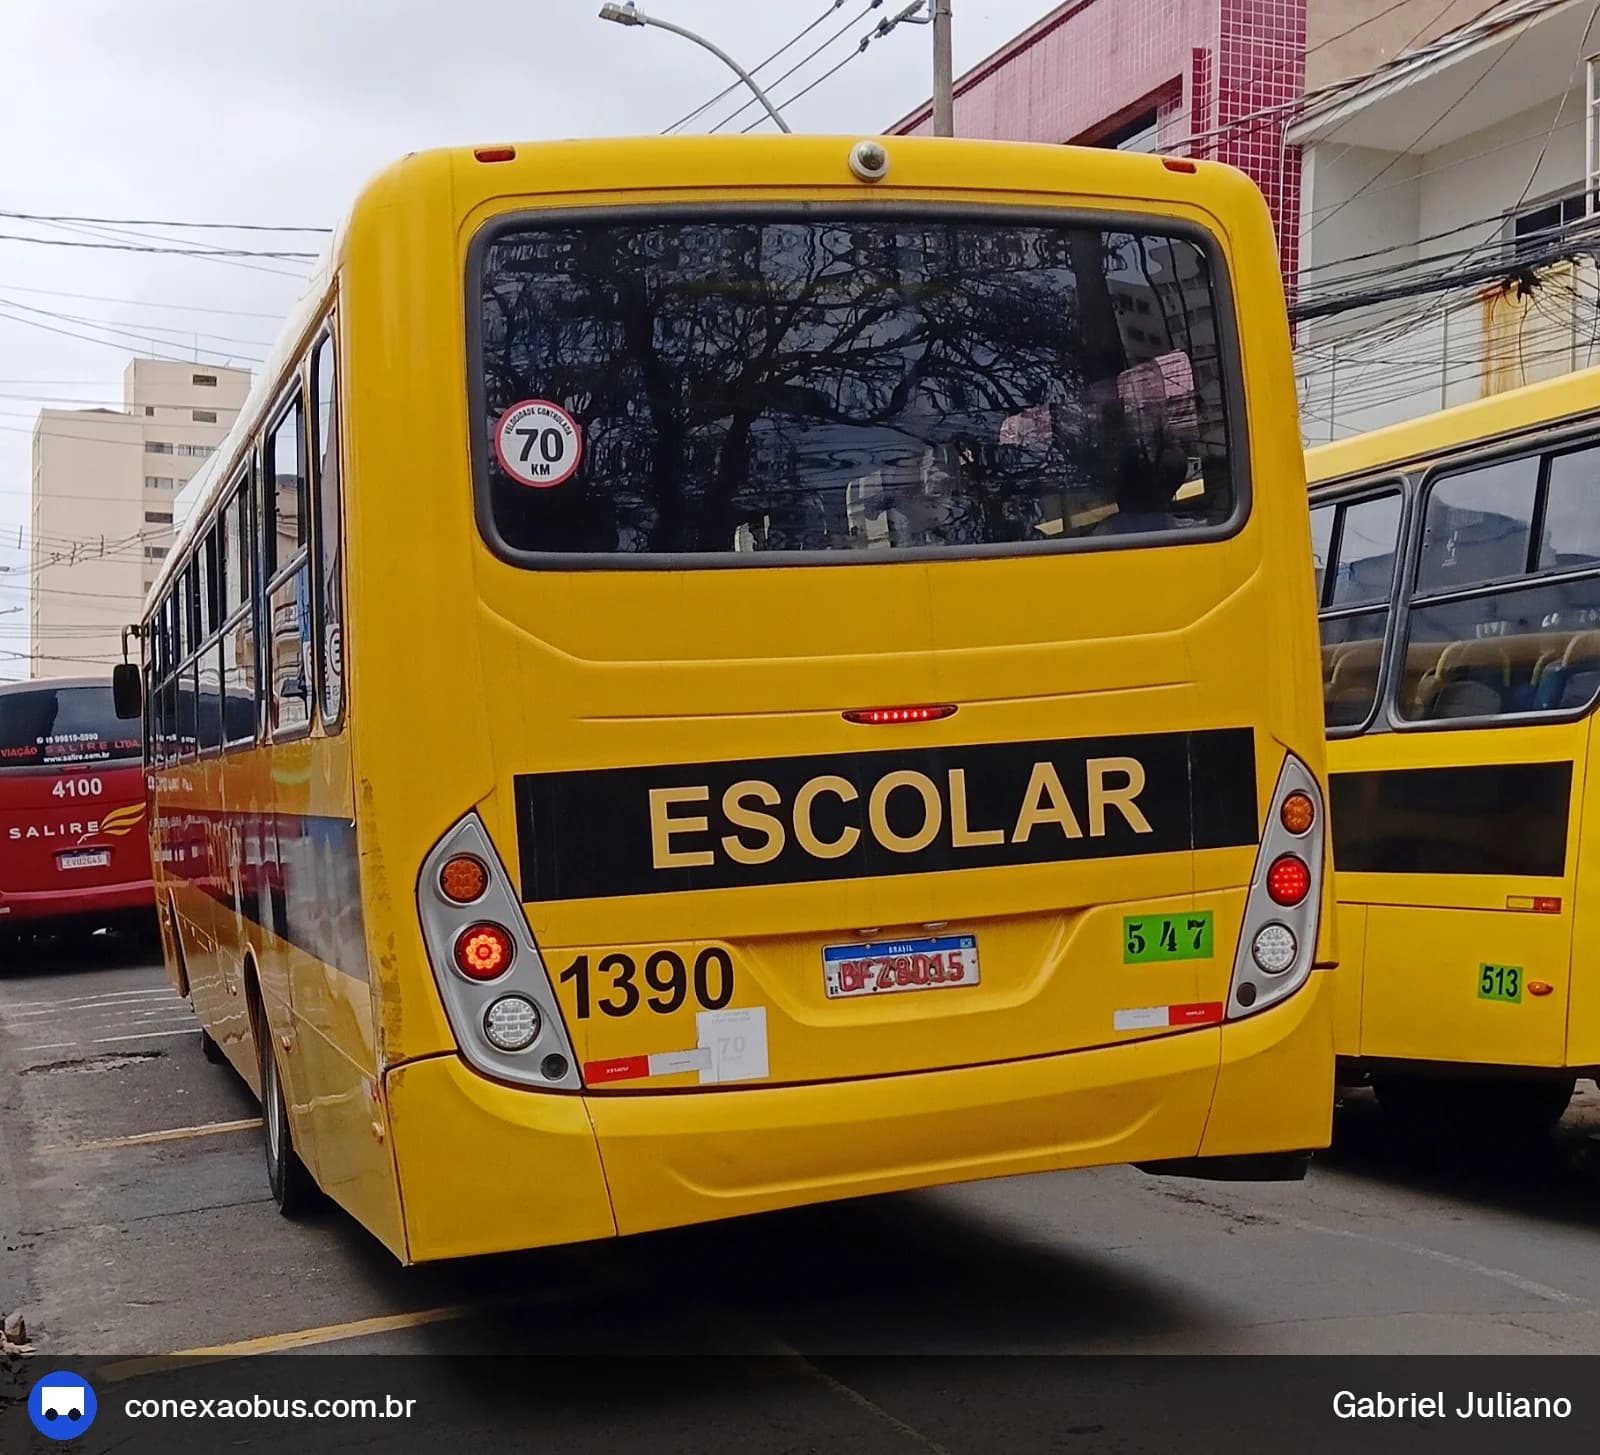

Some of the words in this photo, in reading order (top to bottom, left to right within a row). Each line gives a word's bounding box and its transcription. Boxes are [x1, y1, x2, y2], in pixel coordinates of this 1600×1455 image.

[504, 407, 535, 435] VELOCIDADE
[537, 407, 573, 436] CONTROLADA
[515, 427, 564, 463] 70
[530, 463, 551, 476] KM
[1, 746, 38, 758] VIAÇÃO
[45, 741, 109, 755] SALIRE
[43, 751, 110, 763] www.salire.com.br
[52, 778, 103, 798] 4100
[648, 755, 1154, 870] ESCOLAR
[9, 820, 99, 840] SALIRE
[888, 945, 914, 954] BRASIL
[560, 947, 734, 1019] 1390
[1481, 965, 1519, 998] 513
